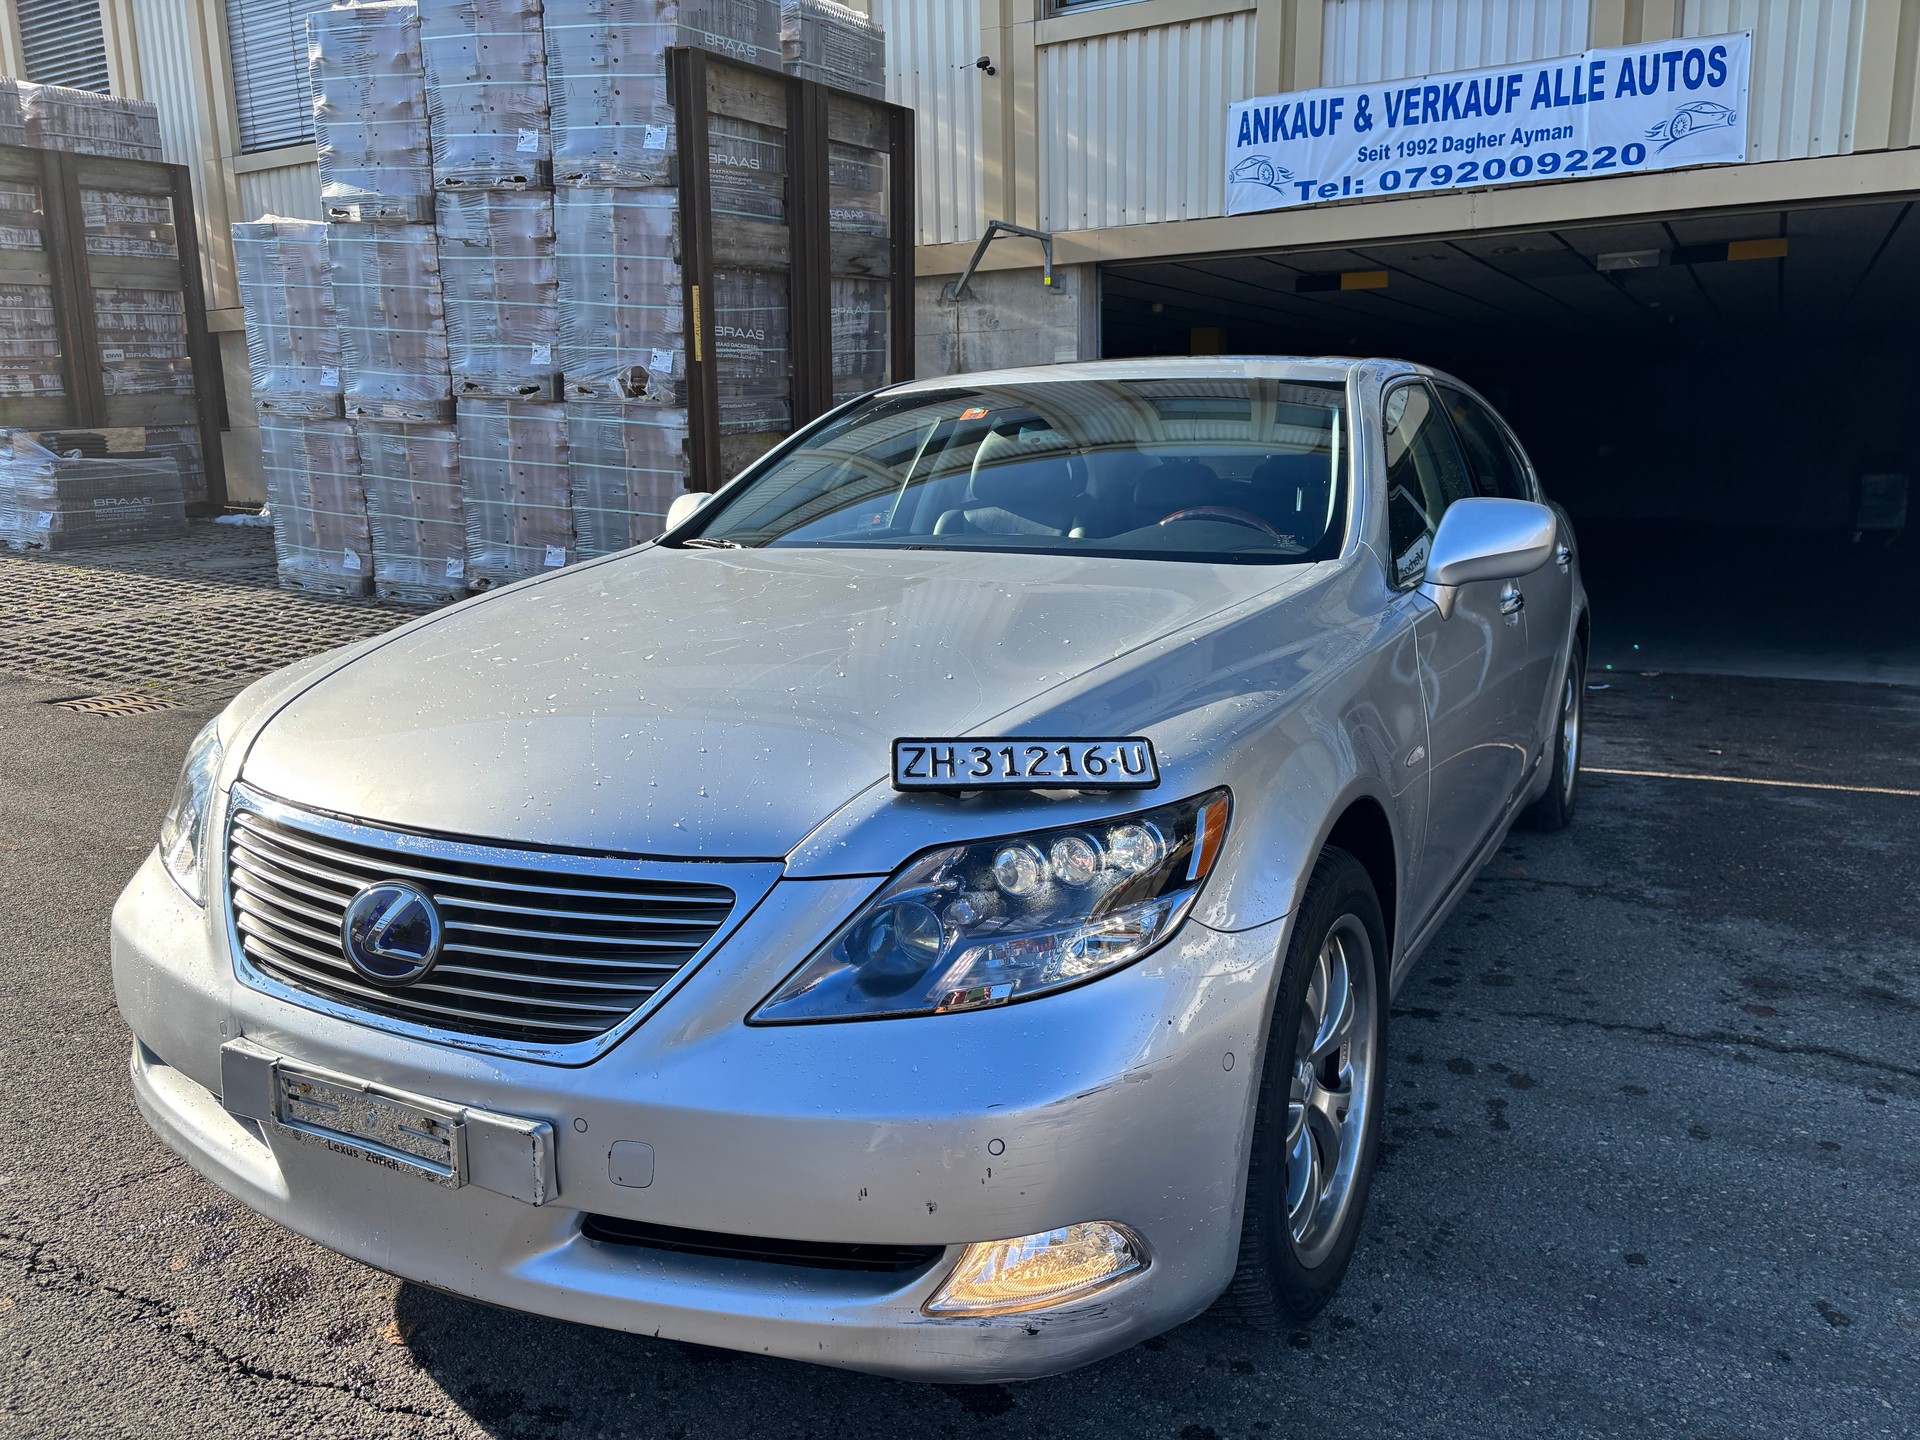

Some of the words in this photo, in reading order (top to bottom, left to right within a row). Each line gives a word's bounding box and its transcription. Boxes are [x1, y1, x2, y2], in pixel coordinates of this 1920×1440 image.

[704, 32, 757, 57] BRAAS
[1237, 97, 1344, 148] ANKAUF
[1353, 94, 1374, 133] &
[1384, 74, 1523, 128] VERKAUF
[1530, 60, 1606, 111] ALLE
[1614, 45, 1728, 99] AUTOS
[1357, 144, 1391, 163] Seit
[1397, 137, 1438, 158] 1992
[1442, 132, 1506, 154] Dagher
[1511, 124, 1574, 147] Ayman
[1294, 176, 1364, 201] Tel:
[1379, 142, 1646, 191] 0792009220
[714, 325, 765, 341] BRAAS
[328, 1139, 359, 1157] Lexus
[365, 1150, 399, 1171] Zürich
